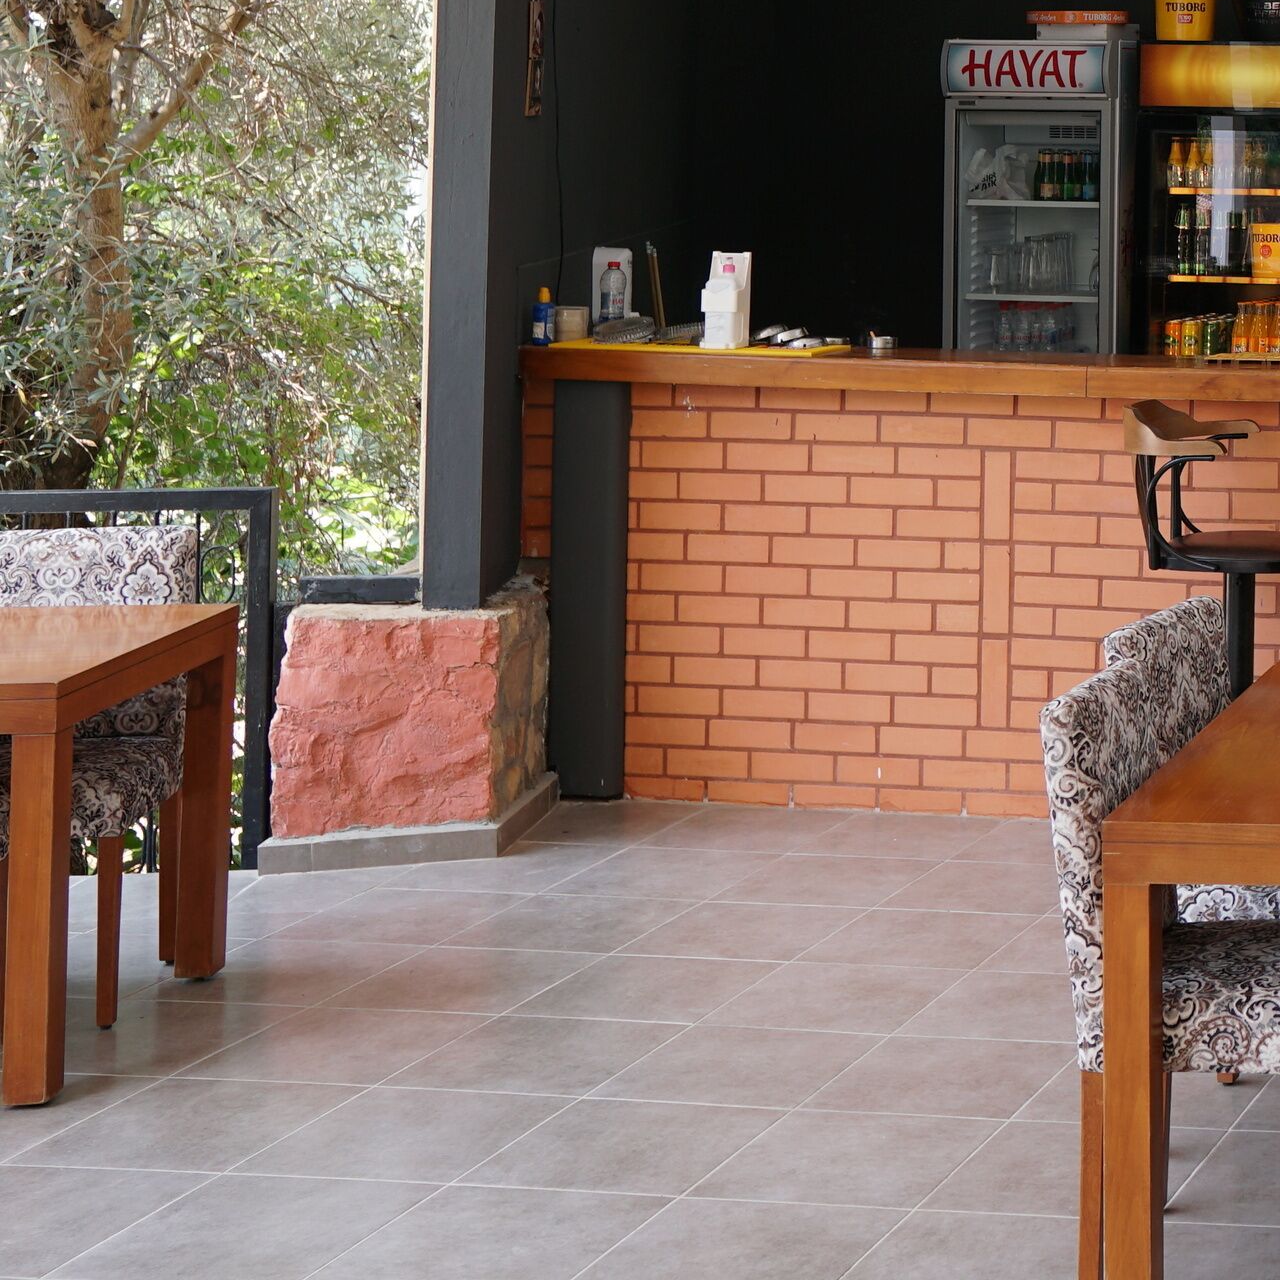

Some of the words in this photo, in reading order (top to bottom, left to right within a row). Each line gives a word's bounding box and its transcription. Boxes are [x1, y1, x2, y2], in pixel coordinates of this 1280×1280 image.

[1165, 2, 1206, 12] TUBORG
[1083, 13, 1112, 22] TUBORG
[961, 49, 1088, 88] HAYAT
